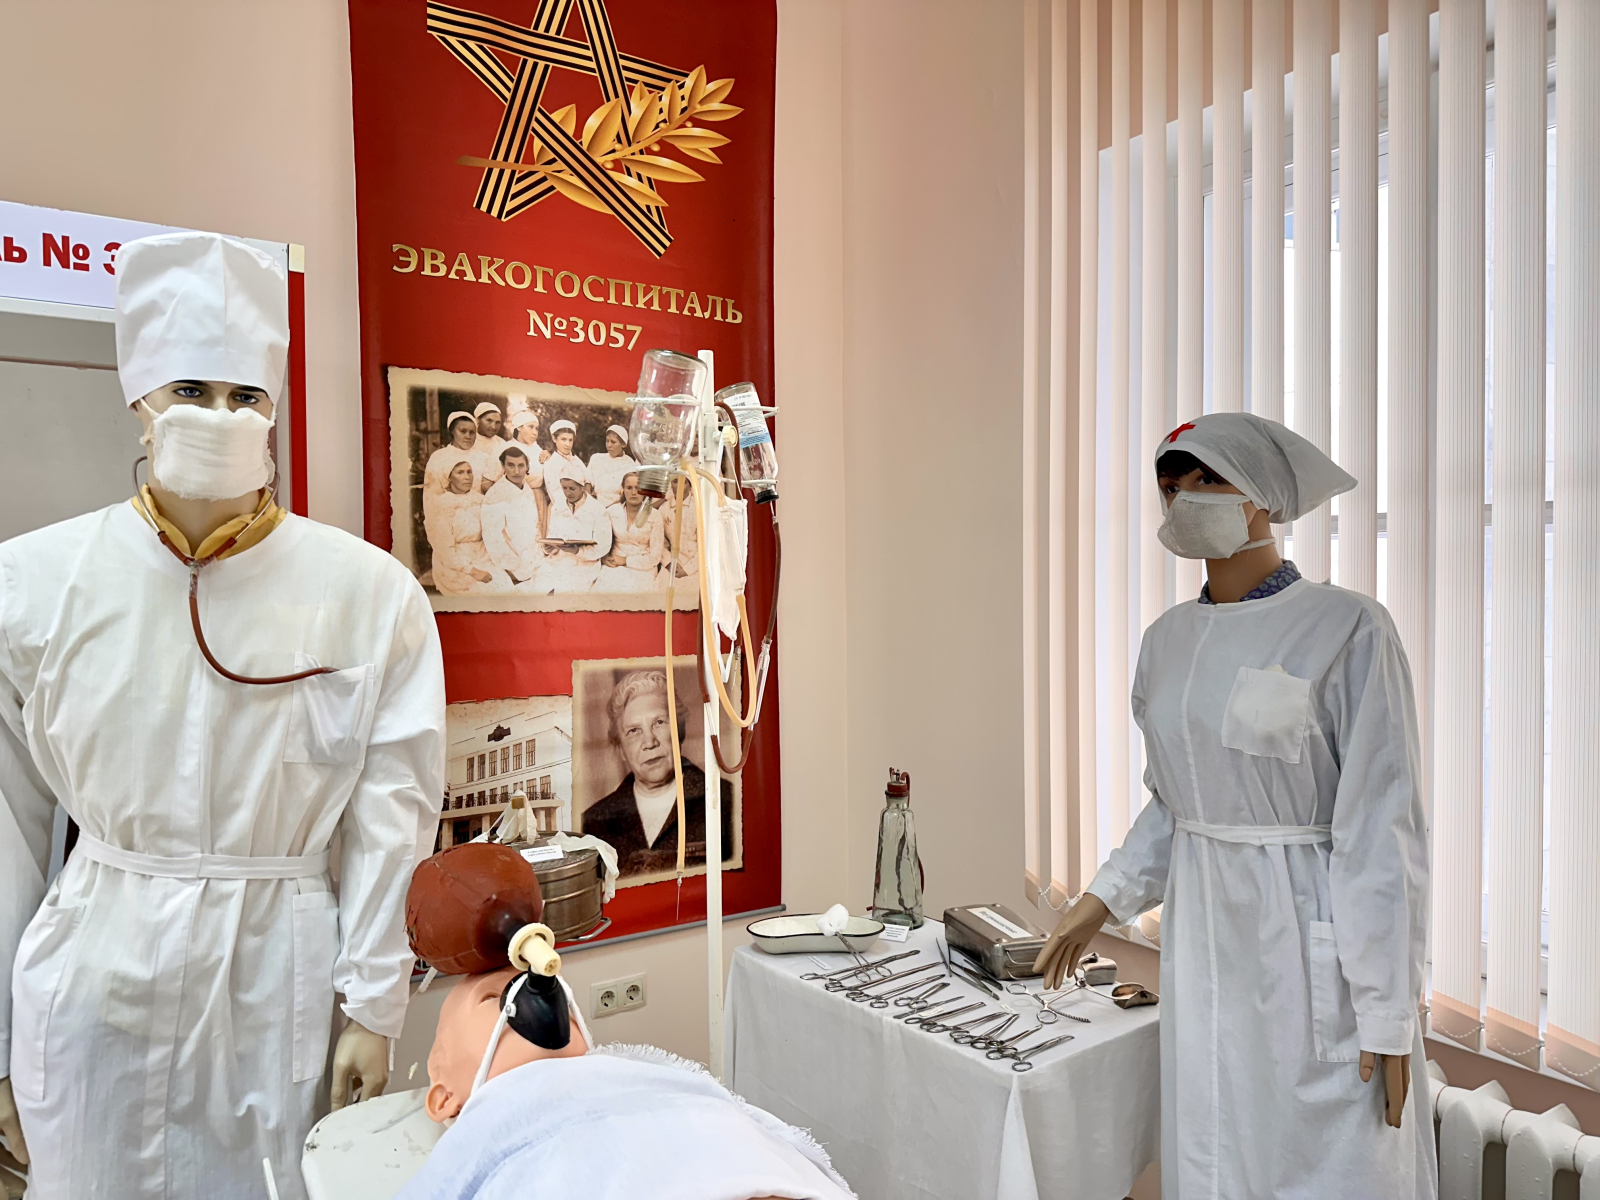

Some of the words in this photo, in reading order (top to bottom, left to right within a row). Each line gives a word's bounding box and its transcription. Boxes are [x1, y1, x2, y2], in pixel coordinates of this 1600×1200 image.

[42, 232, 90, 272] №
[391, 243, 743, 324] ЭВАКОГОСПИТАЛЬ
[526, 309, 643, 351] №3057
